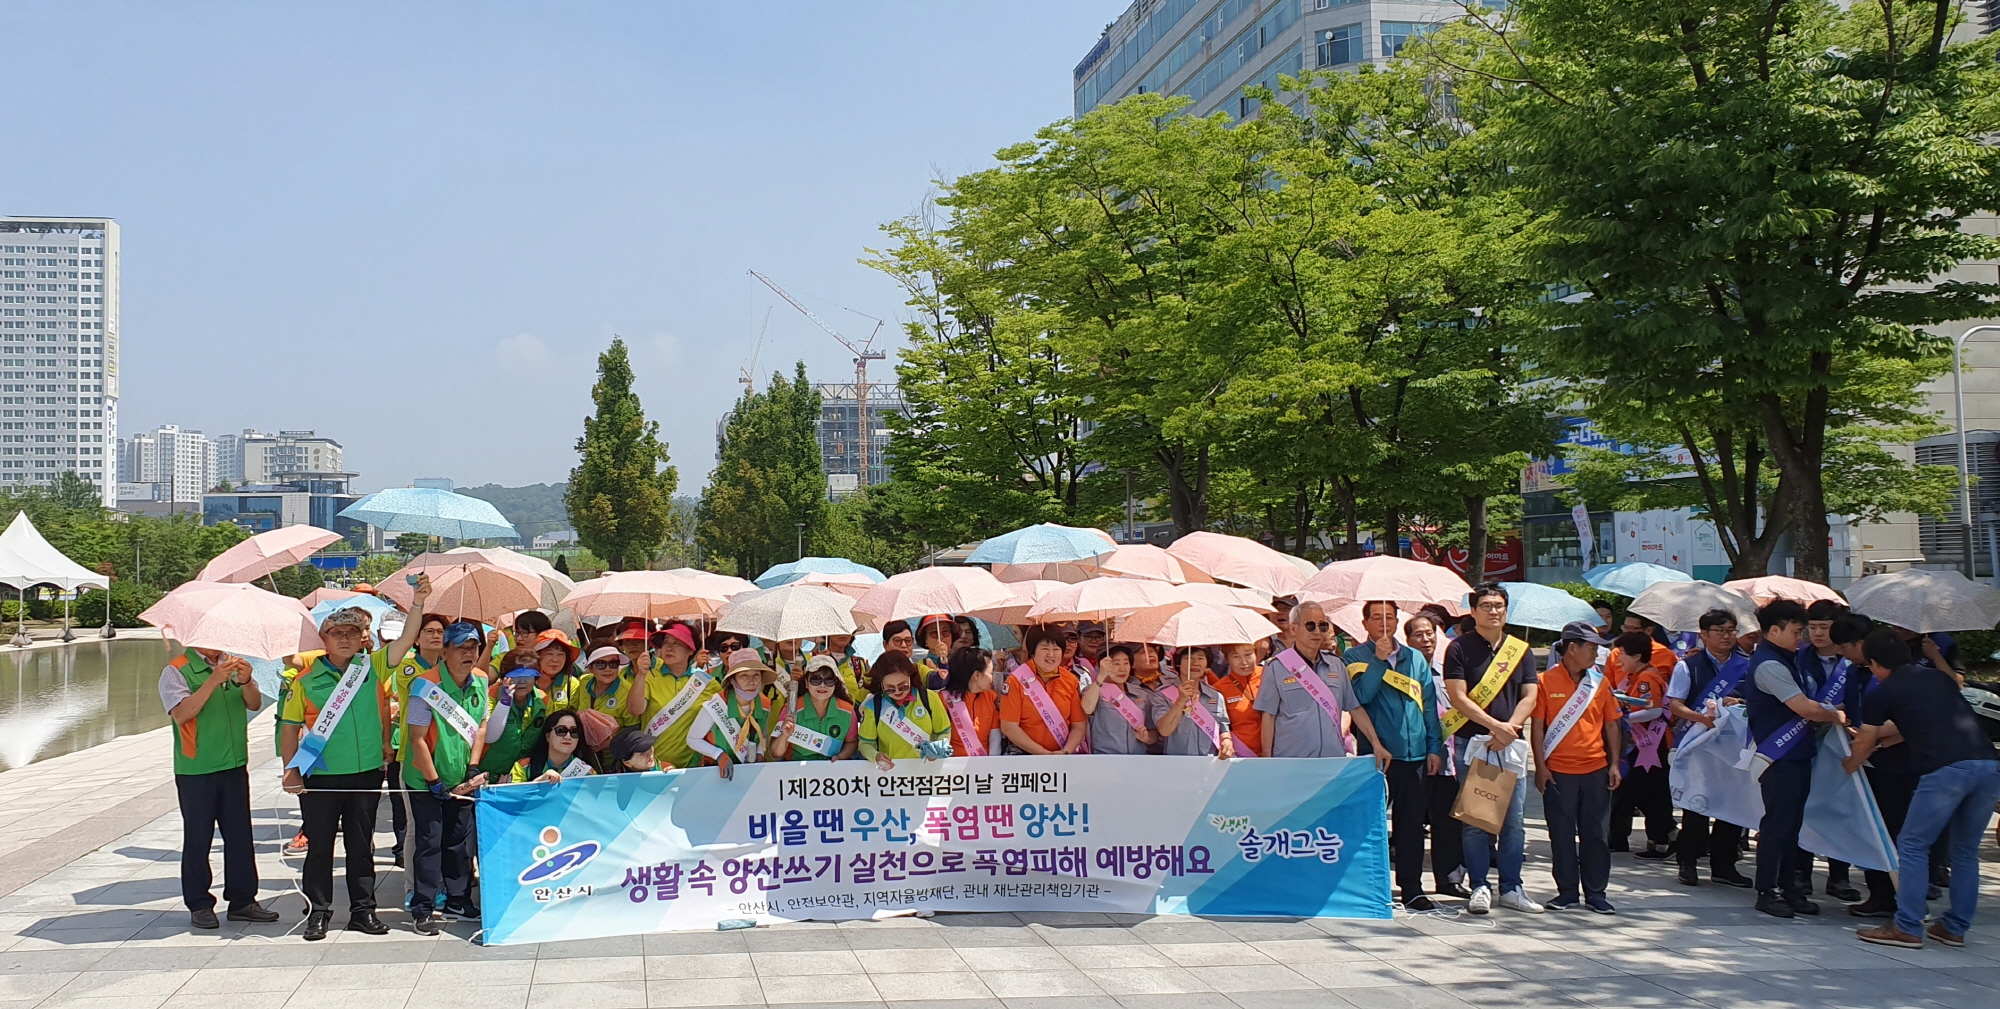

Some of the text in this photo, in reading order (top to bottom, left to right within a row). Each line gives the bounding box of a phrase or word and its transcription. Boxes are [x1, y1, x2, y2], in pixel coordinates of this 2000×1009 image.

[1486, 552, 1509, 560] 이마트
[318, 710, 336, 734] 합시다
[877, 772, 970, 798] 안전점검의
[975, 773, 993, 793] 날
[850, 808, 917, 847] 우산,
[1019, 802, 1090, 837] 양산!
[1239, 827, 1340, 860] 솔개그늘
[620, 844, 1215, 903] 생활 속 양산쓰기 실천으로 폭염피해 예방해요
[738, 882, 1100, 917] 안산시, 안전보안관, 지역자율방재단, 관내 재난관리책임기관
